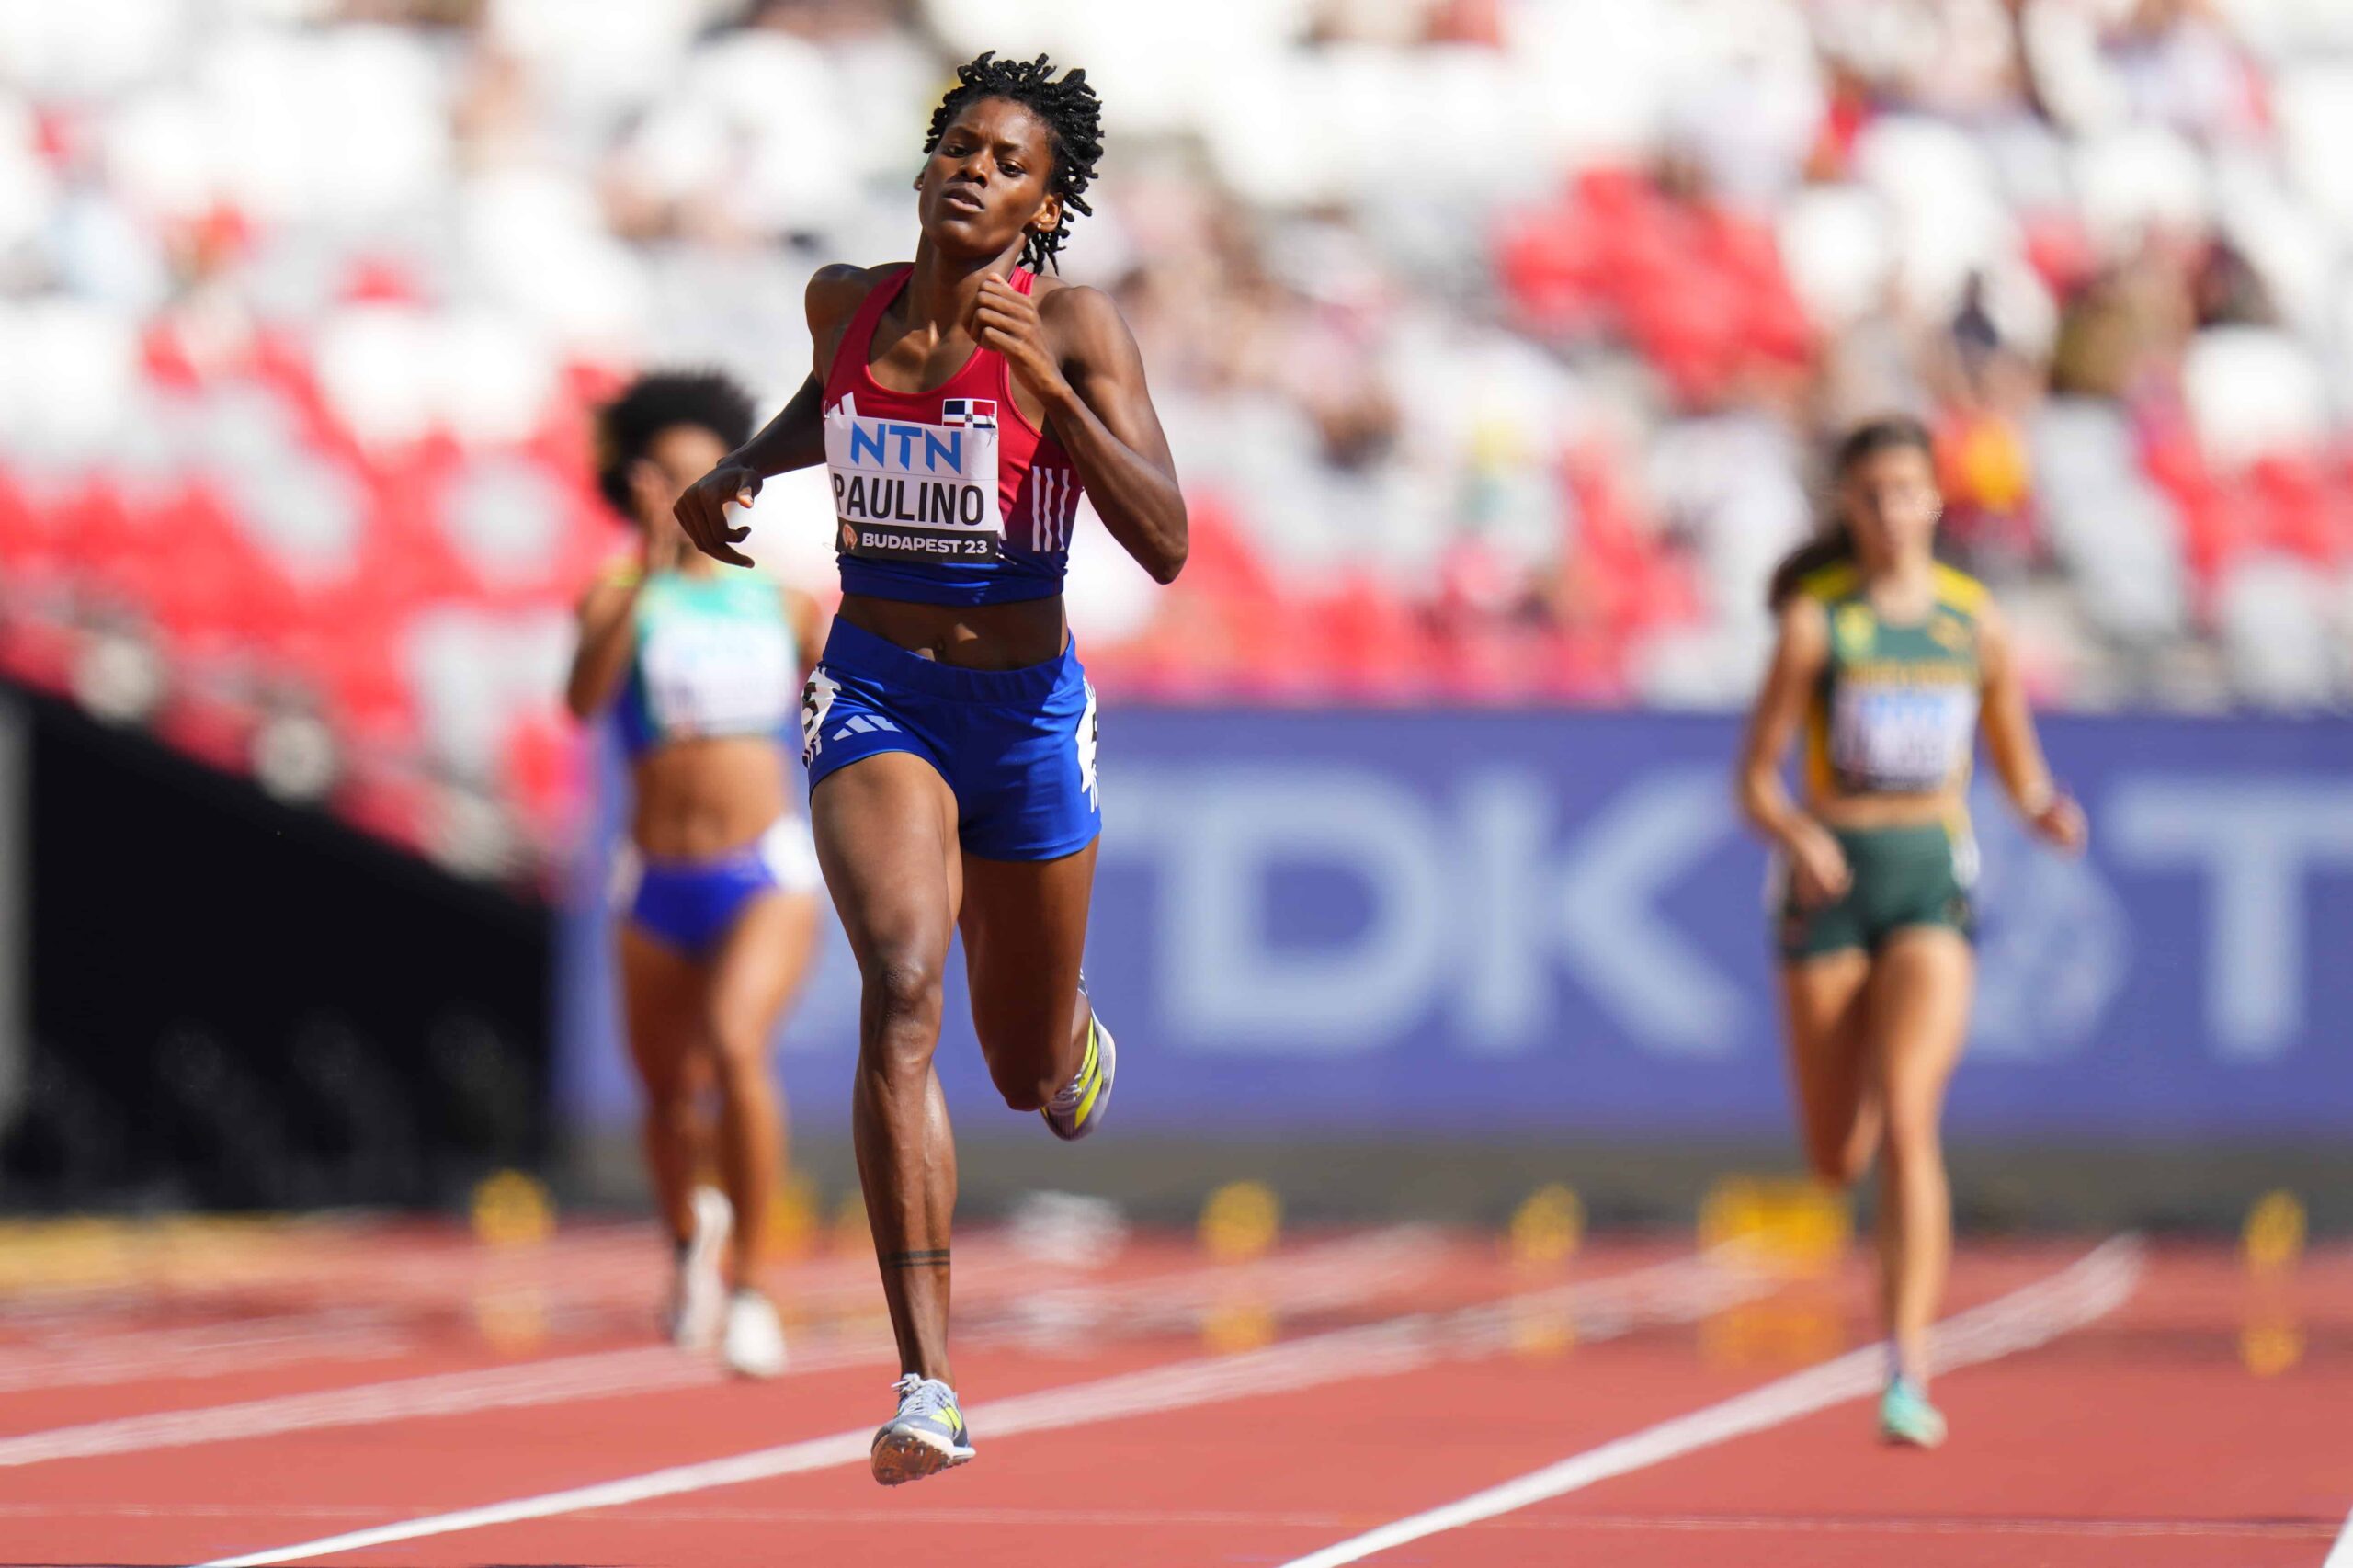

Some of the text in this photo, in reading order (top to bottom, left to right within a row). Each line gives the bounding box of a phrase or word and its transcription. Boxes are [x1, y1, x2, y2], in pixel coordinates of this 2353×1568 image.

[850, 421, 961, 475] NTN
[833, 472, 985, 527] PAULINO
[861, 532, 988, 553] BUDAPEST 23
[1096, 770, 1737, 1053] DK
